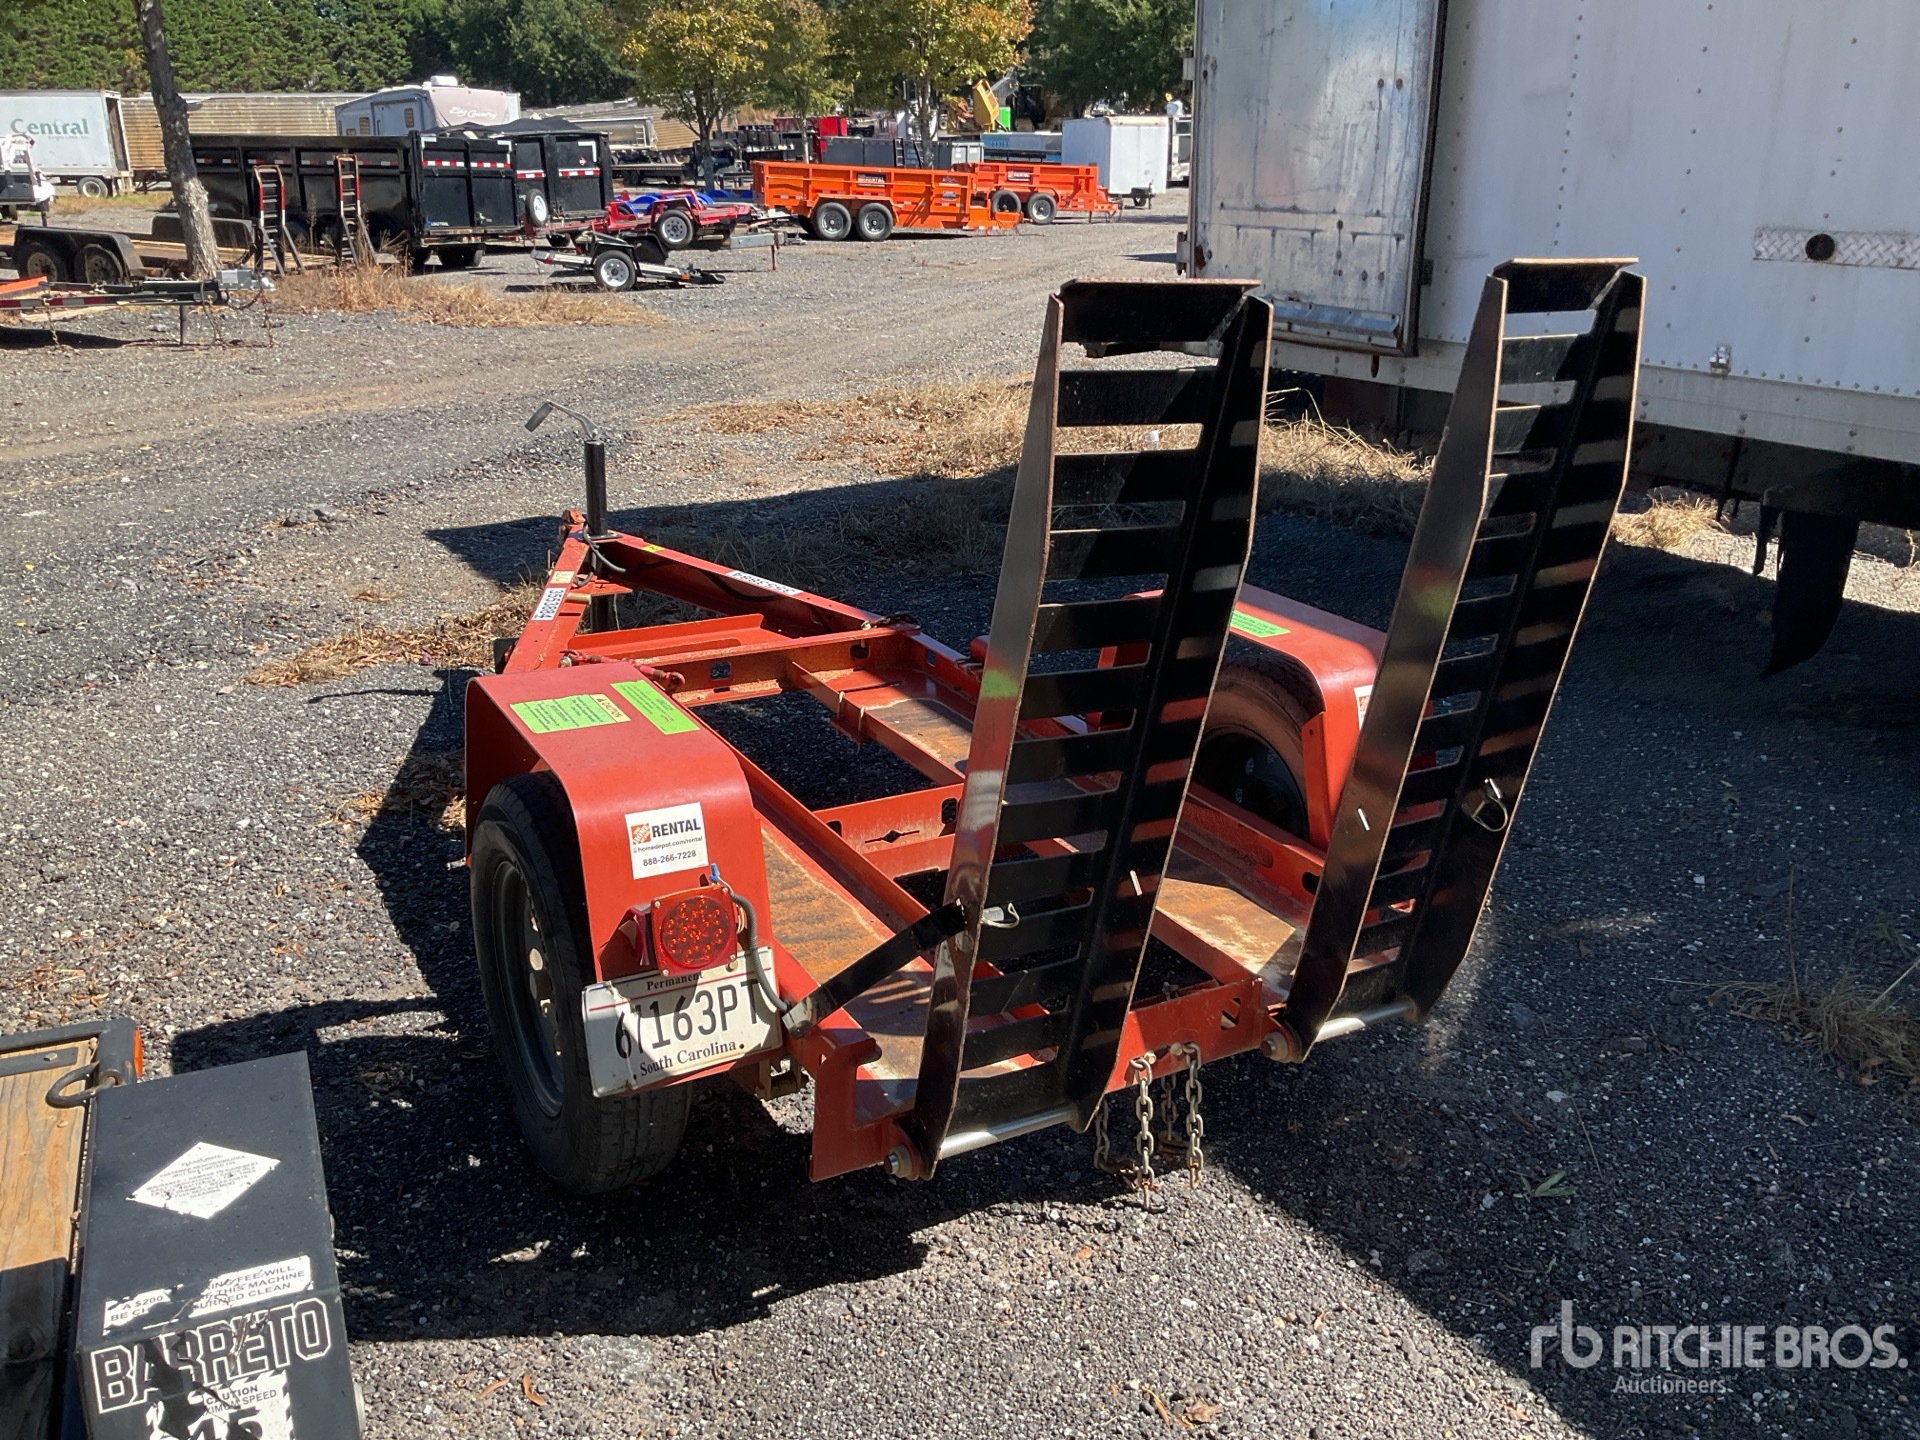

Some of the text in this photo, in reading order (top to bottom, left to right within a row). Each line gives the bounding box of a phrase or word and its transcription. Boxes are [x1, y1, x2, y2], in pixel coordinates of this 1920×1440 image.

[10, 118, 89, 135] Central
[651, 818, 702, 838] RENTAL
[637, 836, 703, 852] homedepot.com/rental
[642, 849, 697, 867] 888-266-7228
[646, 971, 704, 991] Permanent
[640, 1041, 737, 1077] South Carolina
[110, 1312, 128, 1321] BE
[248, 1270, 305, 1288] MACHINE
[122, 1303, 131, 1311] A
[135, 1295, 164, 1308] $200
[264, 1265, 295, 1276] WILL
[248, 1282, 291, 1297] CLEAN
[242, 1389, 278, 1406] SPEED
